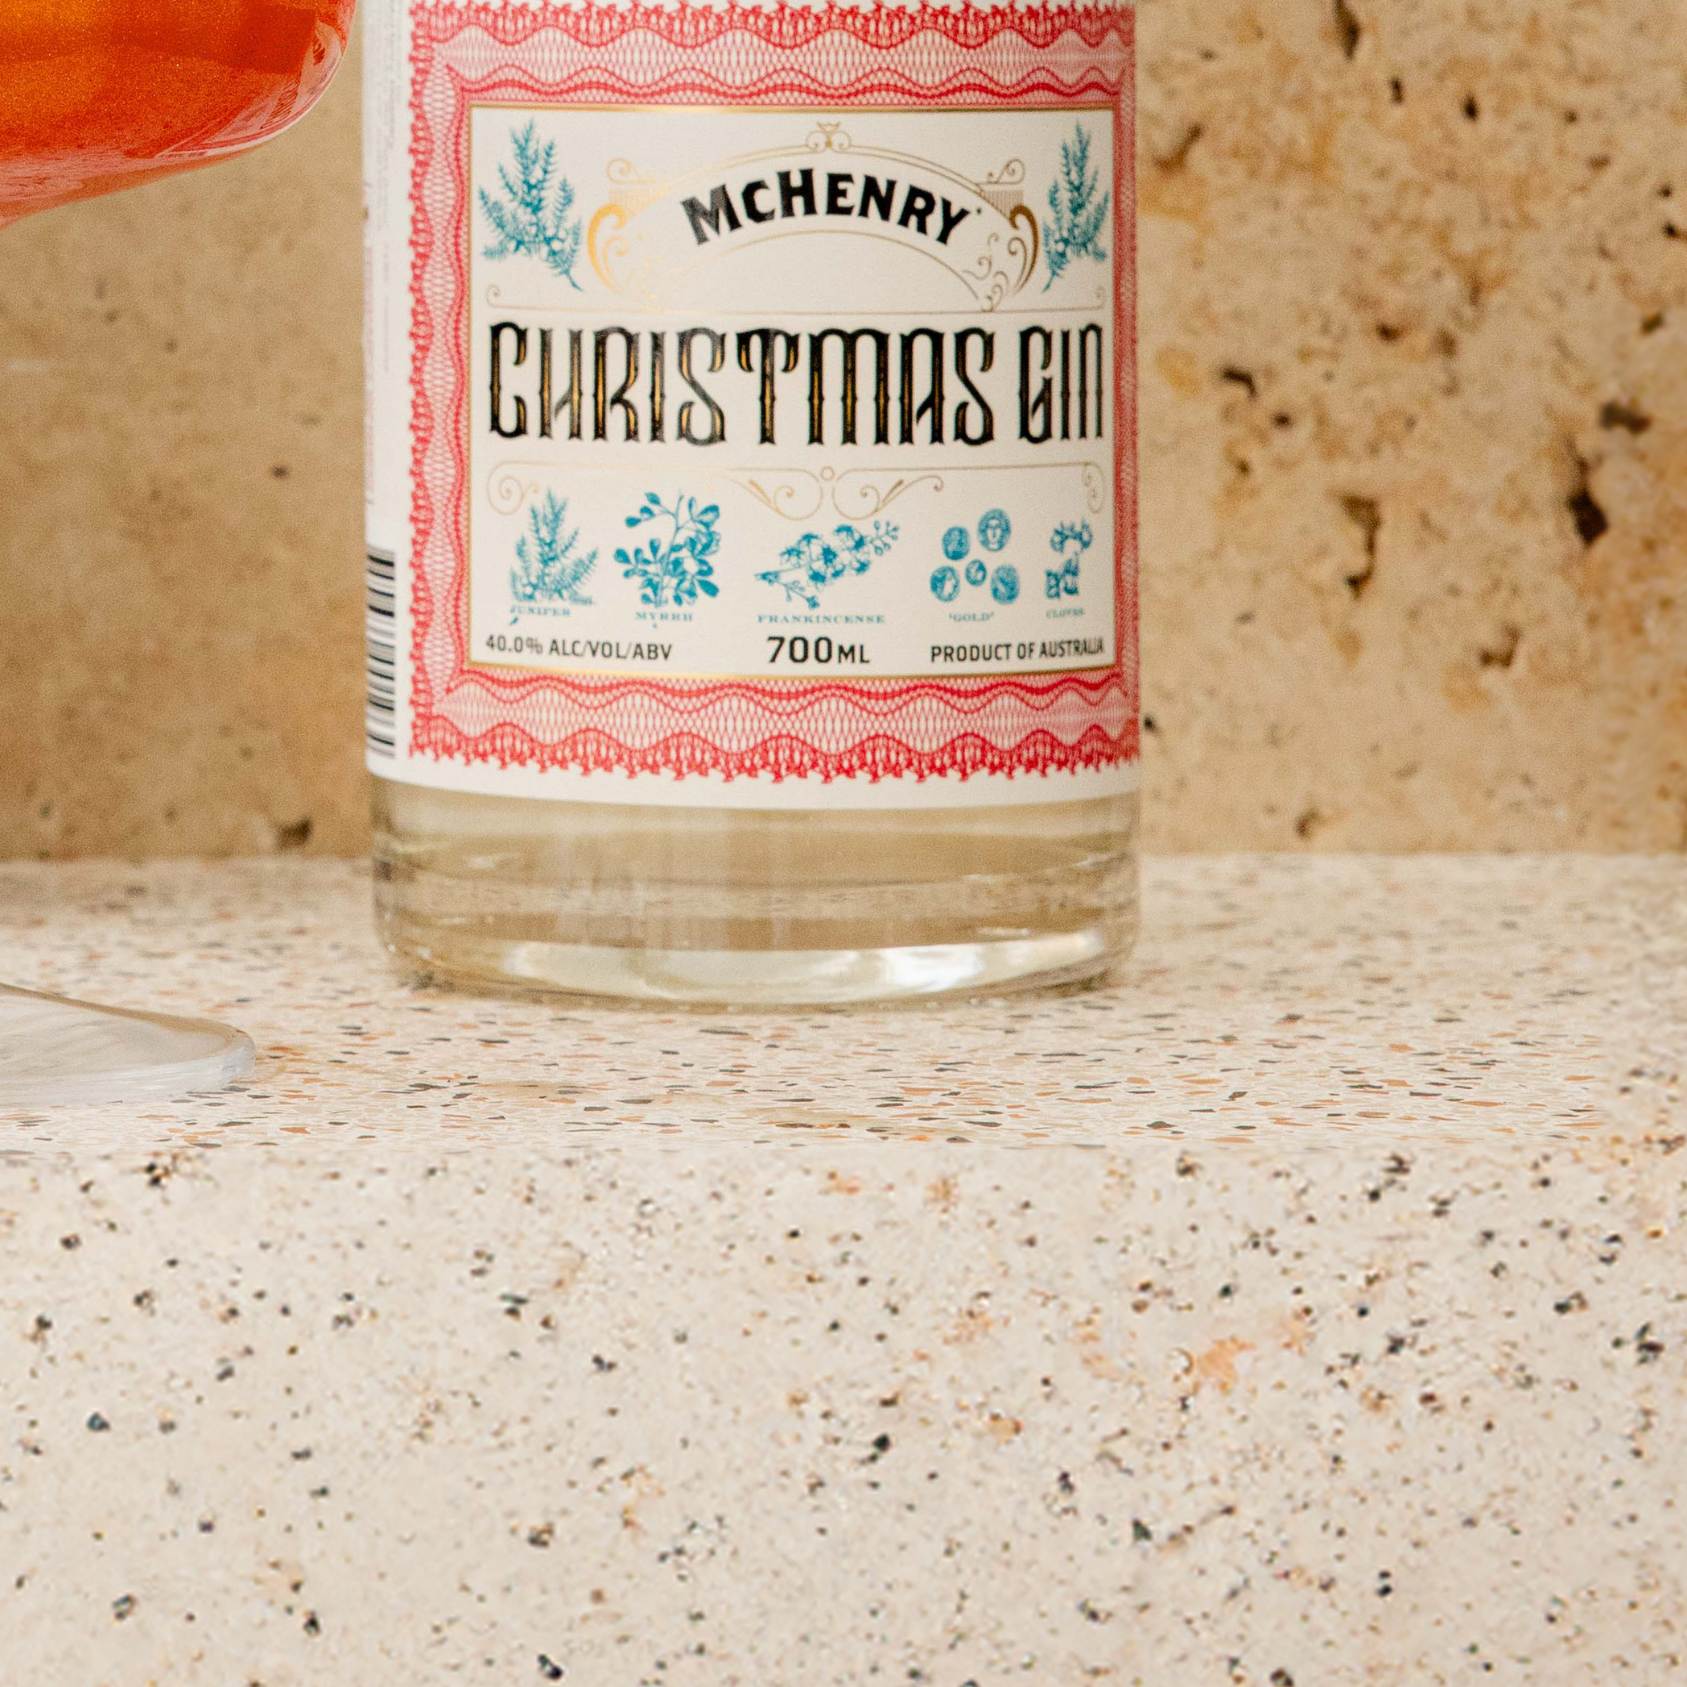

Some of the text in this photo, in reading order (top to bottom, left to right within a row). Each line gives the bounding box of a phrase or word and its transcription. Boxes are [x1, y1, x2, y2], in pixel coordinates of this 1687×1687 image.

[488, 321, 996, 446] CHRISTMAS
[1018, 323, 1103, 444] GIN
[635, 611, 693, 622] MYRRH
[757, 614, 885, 624] FRANKINCENSE
[486, 634, 673, 661] 40.0% ALC/VOL/ABV
[767, 636, 871, 664] 700ML
[931, 636, 1104, 662] PRODUCT OF AUSTRALIA
